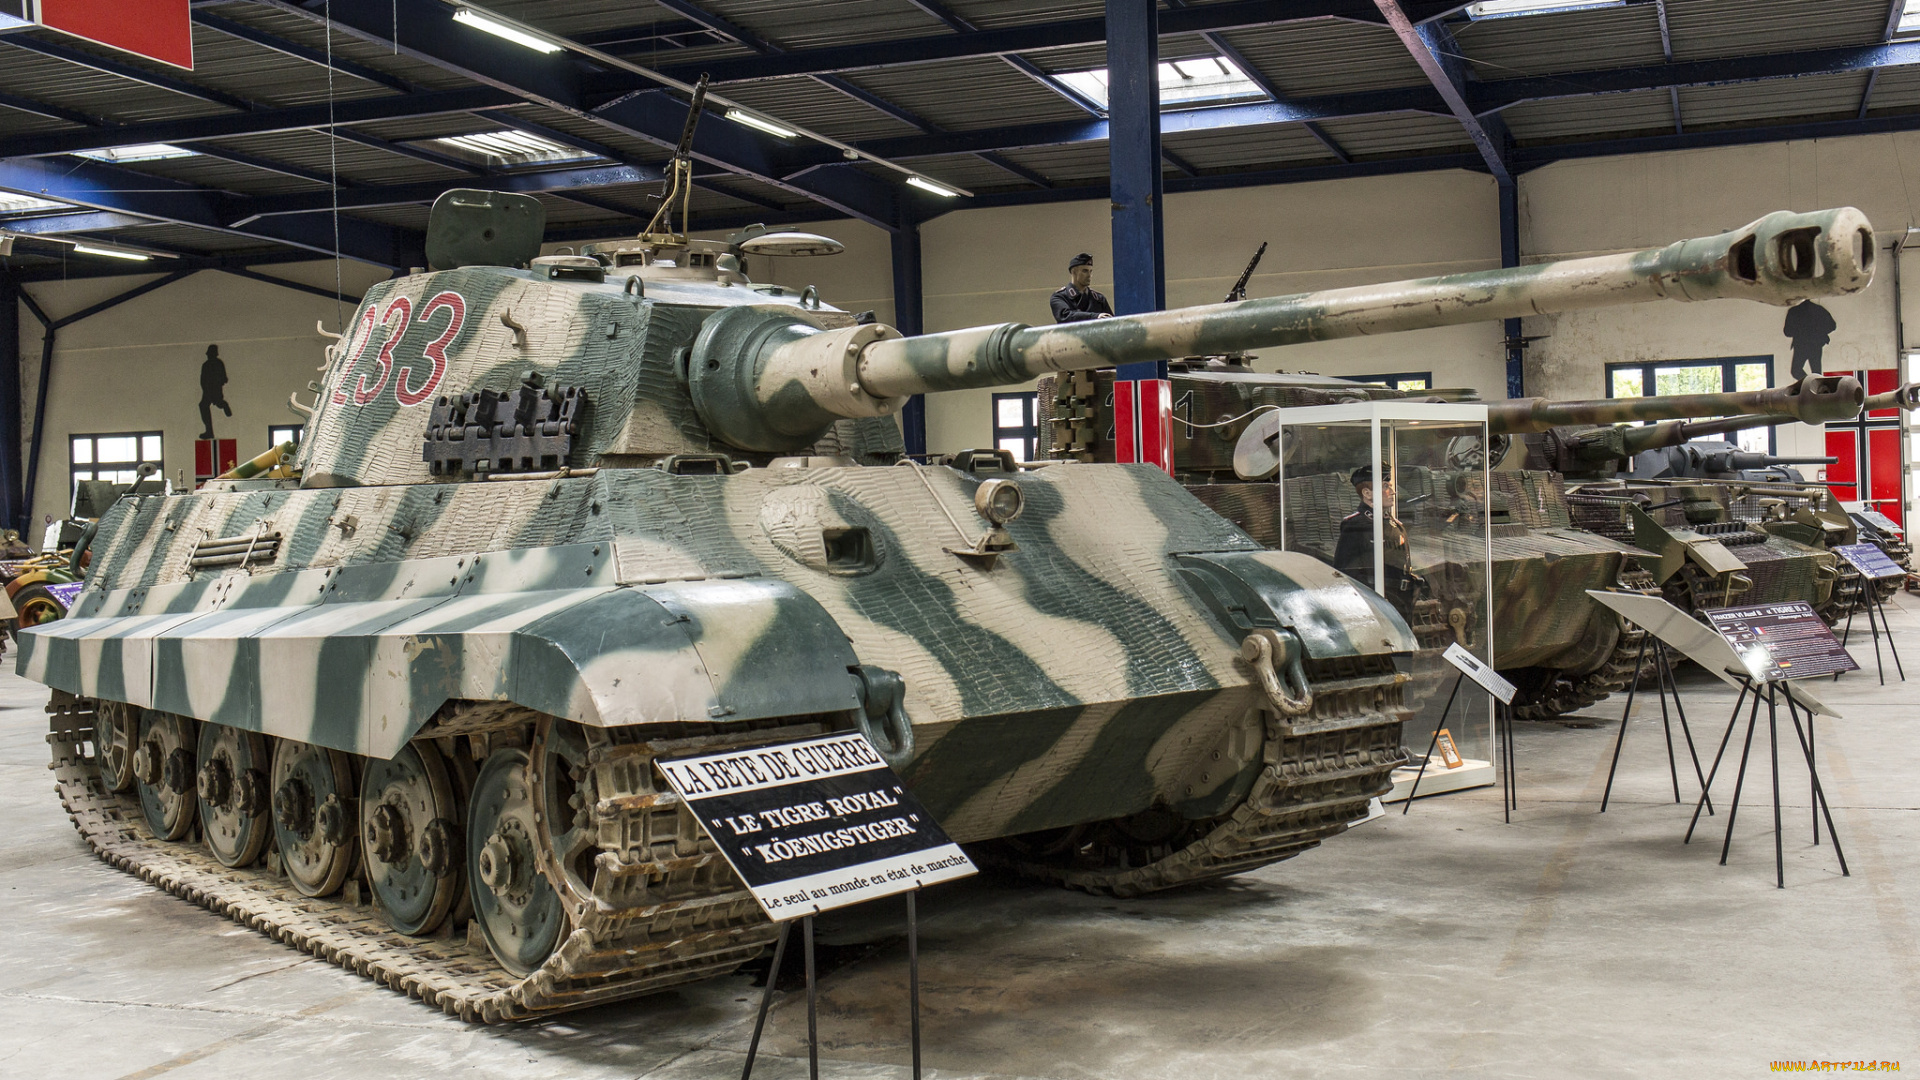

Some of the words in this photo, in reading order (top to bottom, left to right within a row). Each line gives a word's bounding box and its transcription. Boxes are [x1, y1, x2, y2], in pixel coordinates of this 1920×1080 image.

[667, 765, 711, 795] LA
[705, 756, 769, 790] BETE
[757, 751, 800, 780] DE
[792, 738, 880, 775] GUERRE
[759, 801, 830, 828] TIGRE
[761, 897, 783, 909] Le
[783, 889, 811, 906] seul
[810, 889, 828, 899] au
[828, 877, 870, 895] monde
[870, 873, 888, 885] en
[886, 869, 912, 881] état
[910, 863, 927, 876] de
[926, 854, 968, 872] marche
